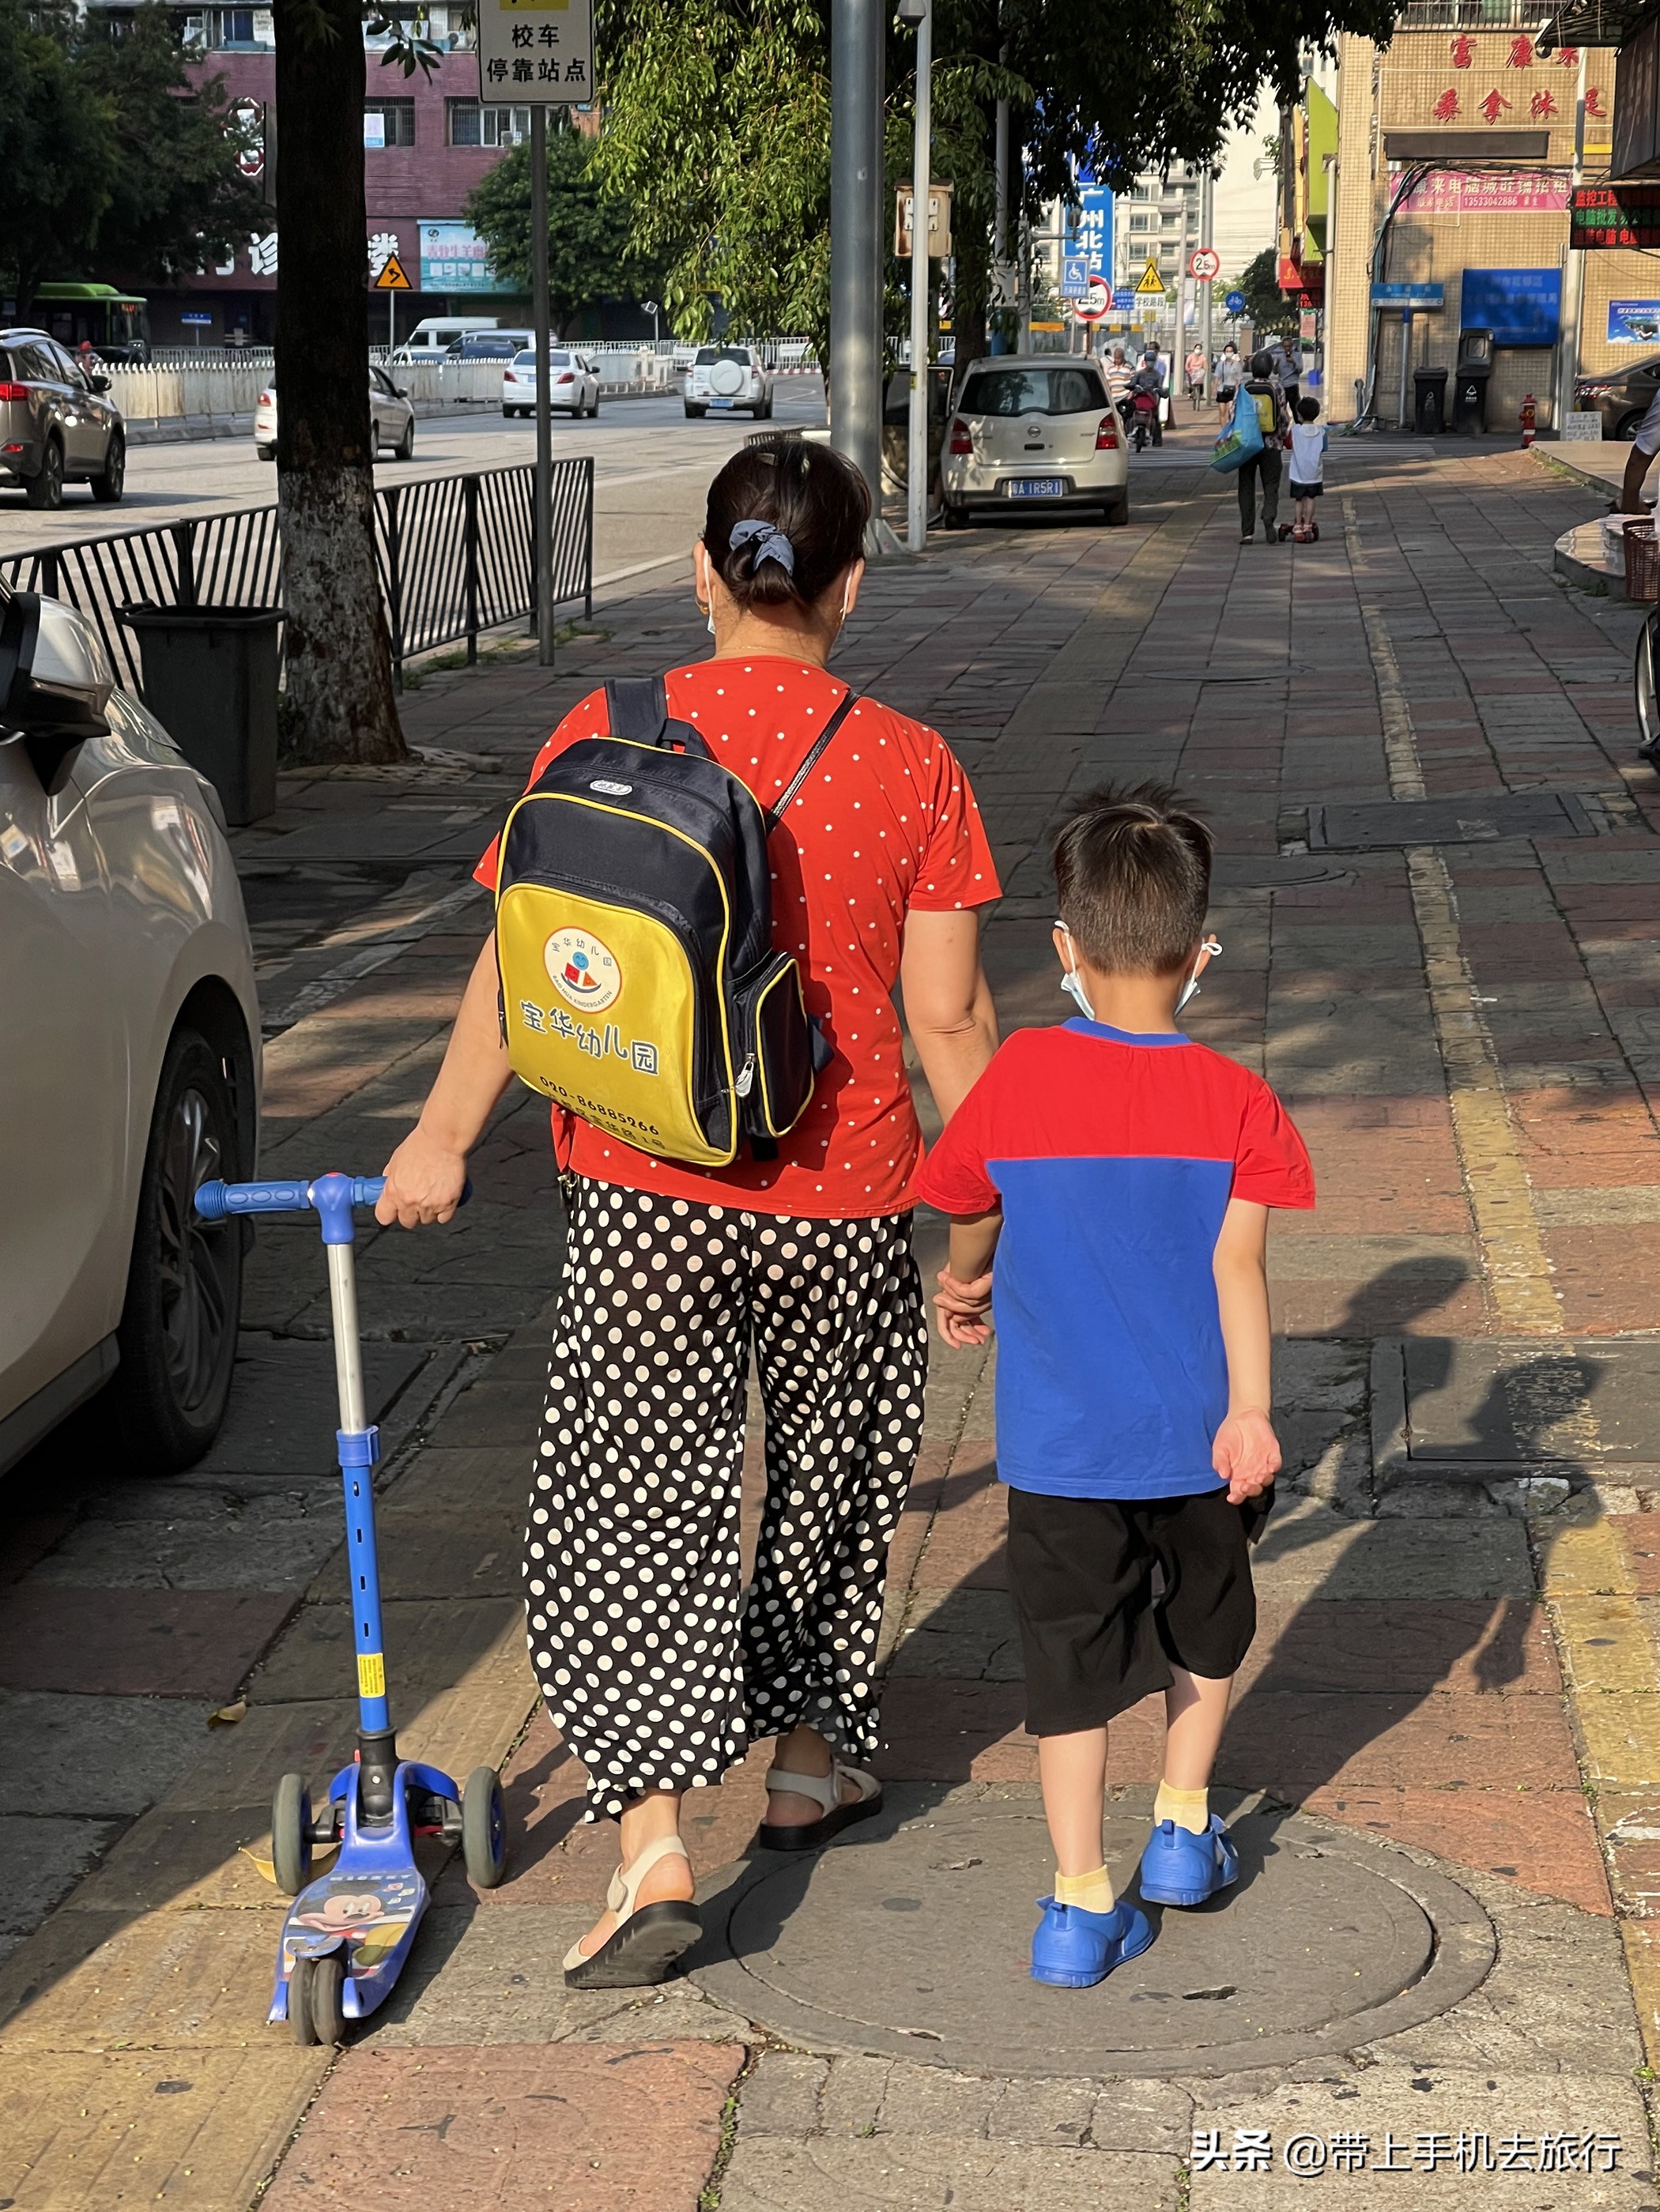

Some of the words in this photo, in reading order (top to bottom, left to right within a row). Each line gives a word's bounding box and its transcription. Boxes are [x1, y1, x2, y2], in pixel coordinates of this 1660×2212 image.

[511, 24, 560, 48] 校车
[487, 58, 587, 82] 停靠站点
[1432, 88, 1607, 125] 桑拿沐足
[1075, 188, 1104, 269] 广州北站
[1136, 296, 1165, 307] 学校路段
[552, 937, 613, 967] 宝华幼儿园
[553, 975, 562, 988] BAO
[562, 988, 573, 1001] HUA
[573, 990, 613, 1008] KINDERGARTEN
[520, 1000, 659, 1076] 宝华幼儿园
[540, 1076, 659, 1136] 020-86885266
